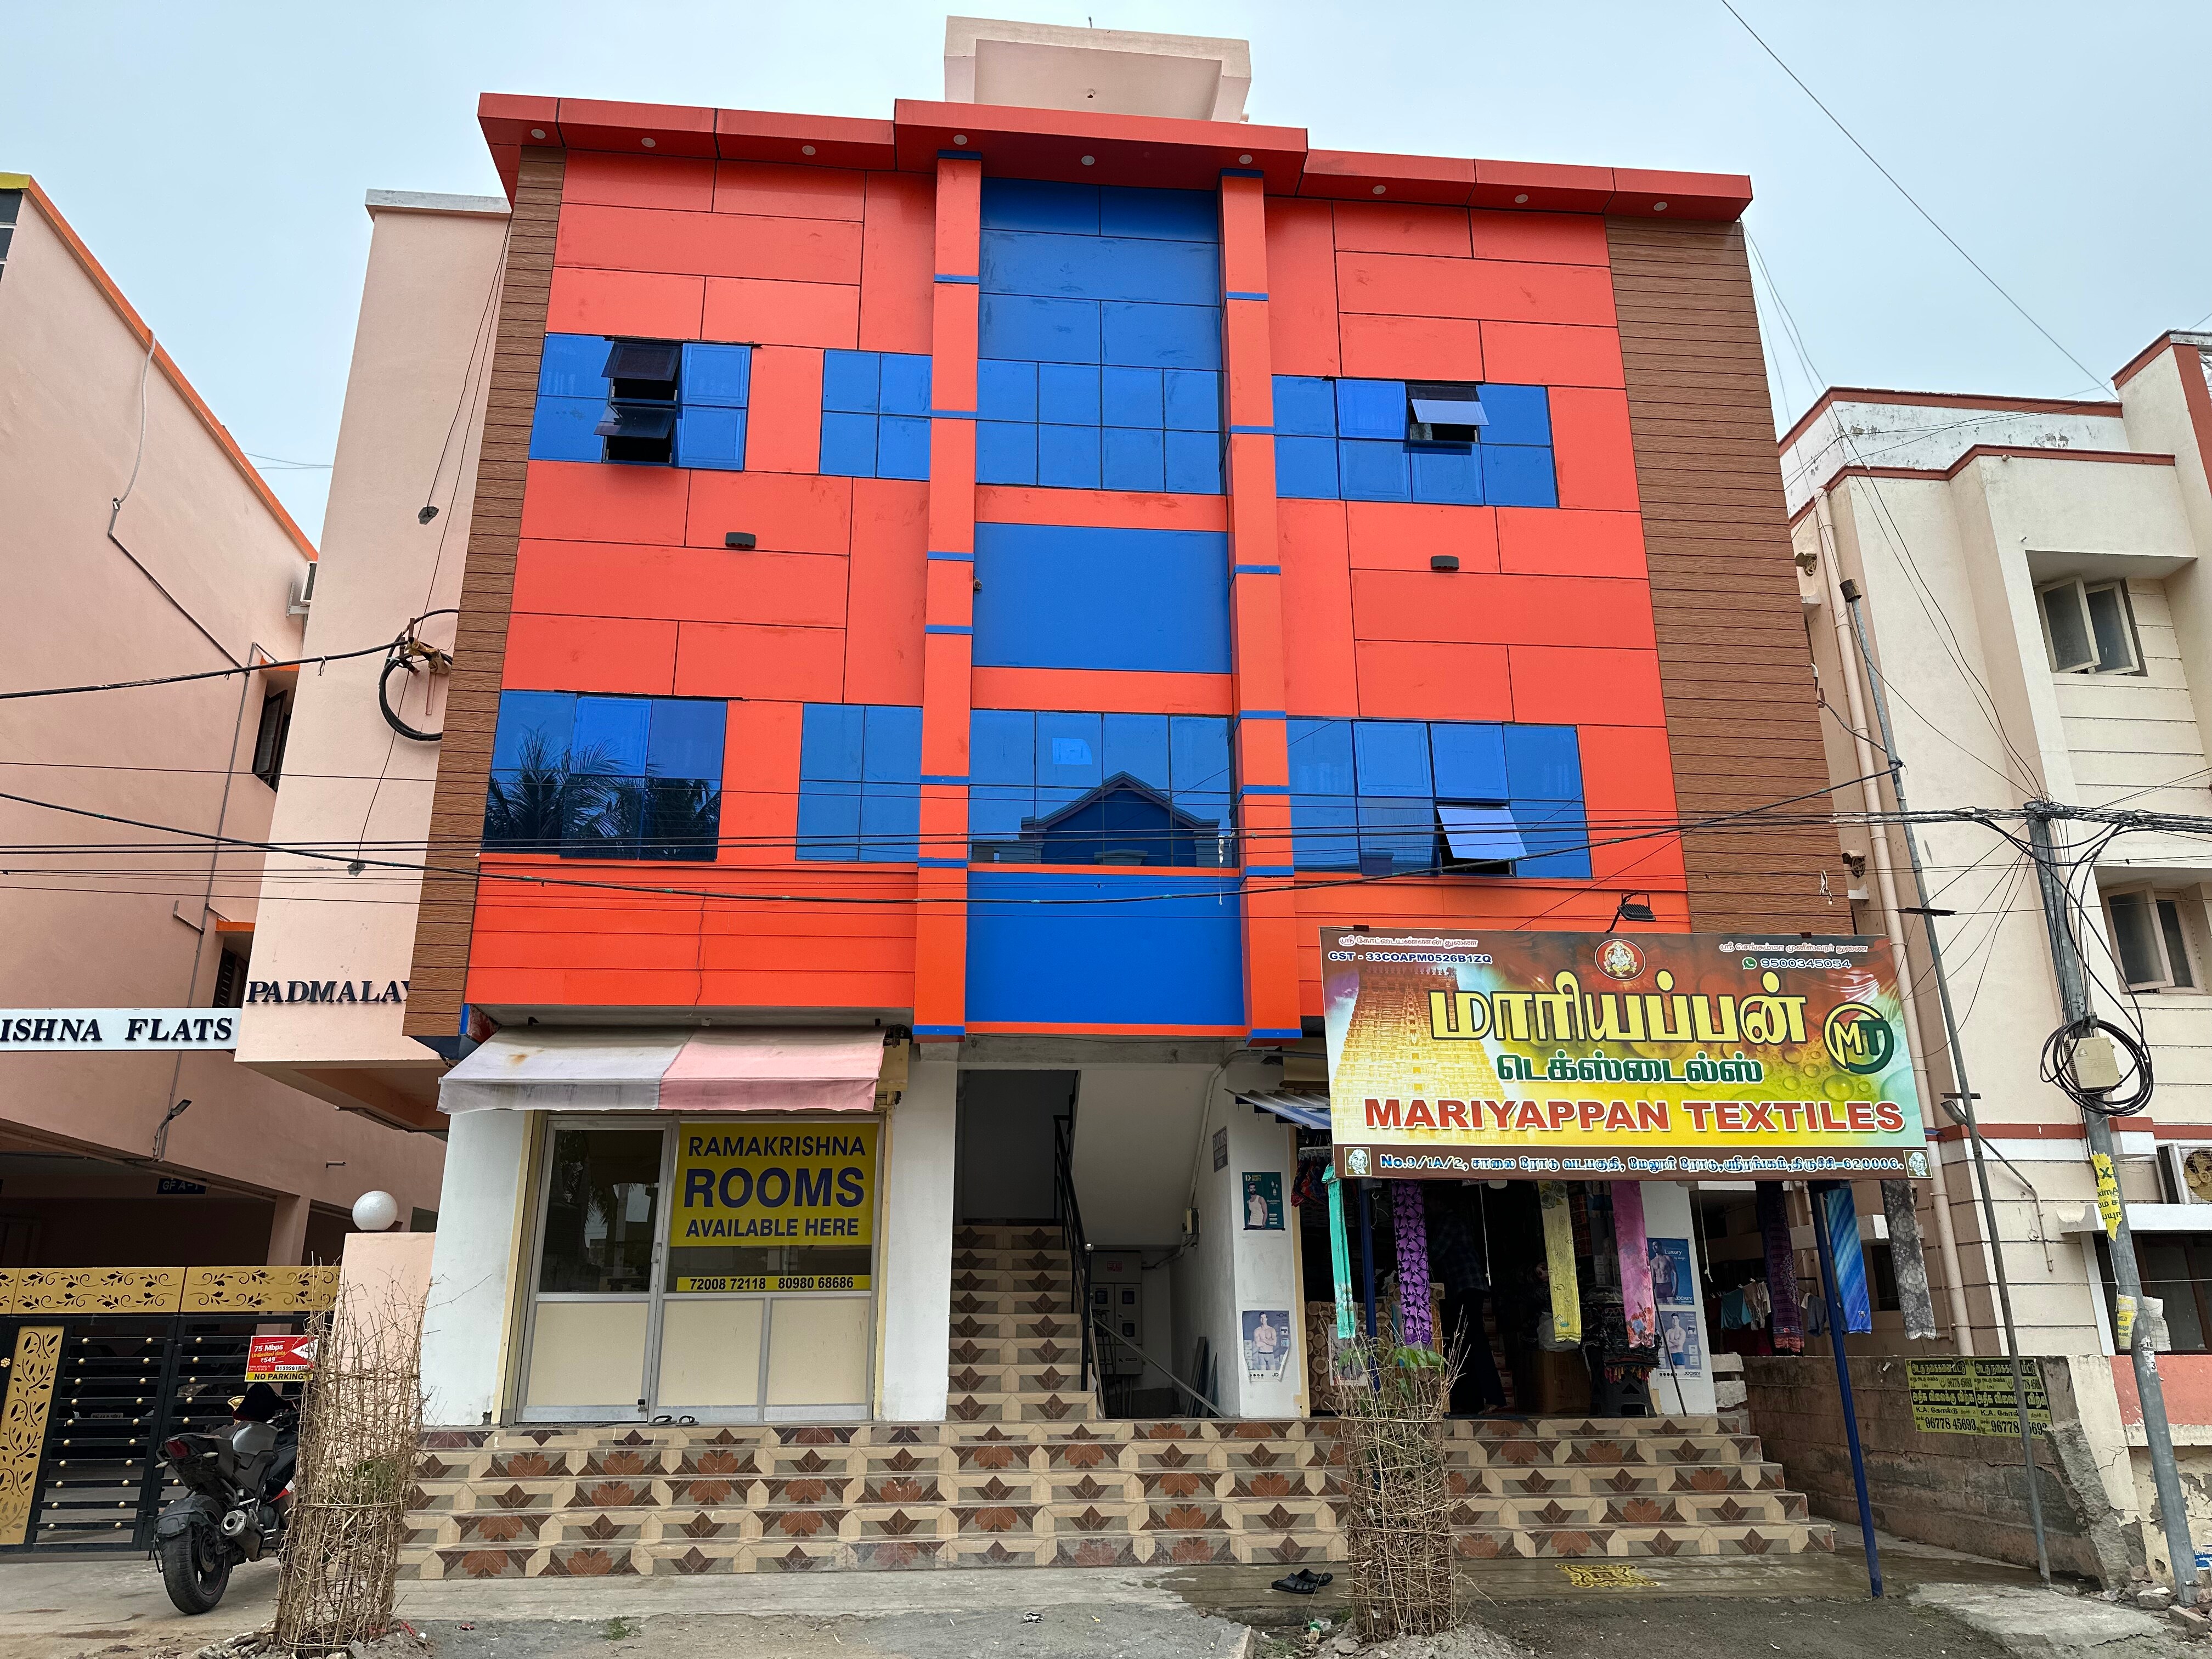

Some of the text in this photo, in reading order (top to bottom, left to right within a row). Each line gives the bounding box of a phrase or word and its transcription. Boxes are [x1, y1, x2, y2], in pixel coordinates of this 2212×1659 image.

[1329, 952, 1355, 961] GST
[1760, 959, 1851, 968] 9500345054
[1428, 969, 1808, 1046] மாரியப்பன்
[125, 1018, 233, 1041] FLATS
[1497, 1049, 1763, 1083] டெக்ஸ்டைல்ஸ்
[1364, 1098, 1905, 1131] MARIYAPPAN TEXTILES
[689, 1136, 866, 1156] RAMAKRISHNA
[1471, 1158, 1516, 1169] சாலை
[1520, 1157, 1560, 1171] ரோடு
[1629, 1157, 1676, 1172] மேலூர்
[684, 1167, 865, 1208] ROOMS
[685, 1218, 859, 1237] AVAILABLE HERE
[690, 1277, 854, 1290] 72008 72118 80980 68686
[1925, 1417, 1976, 1431] 96778 45693
[1991, 1420, 2019, 1434] 96778
